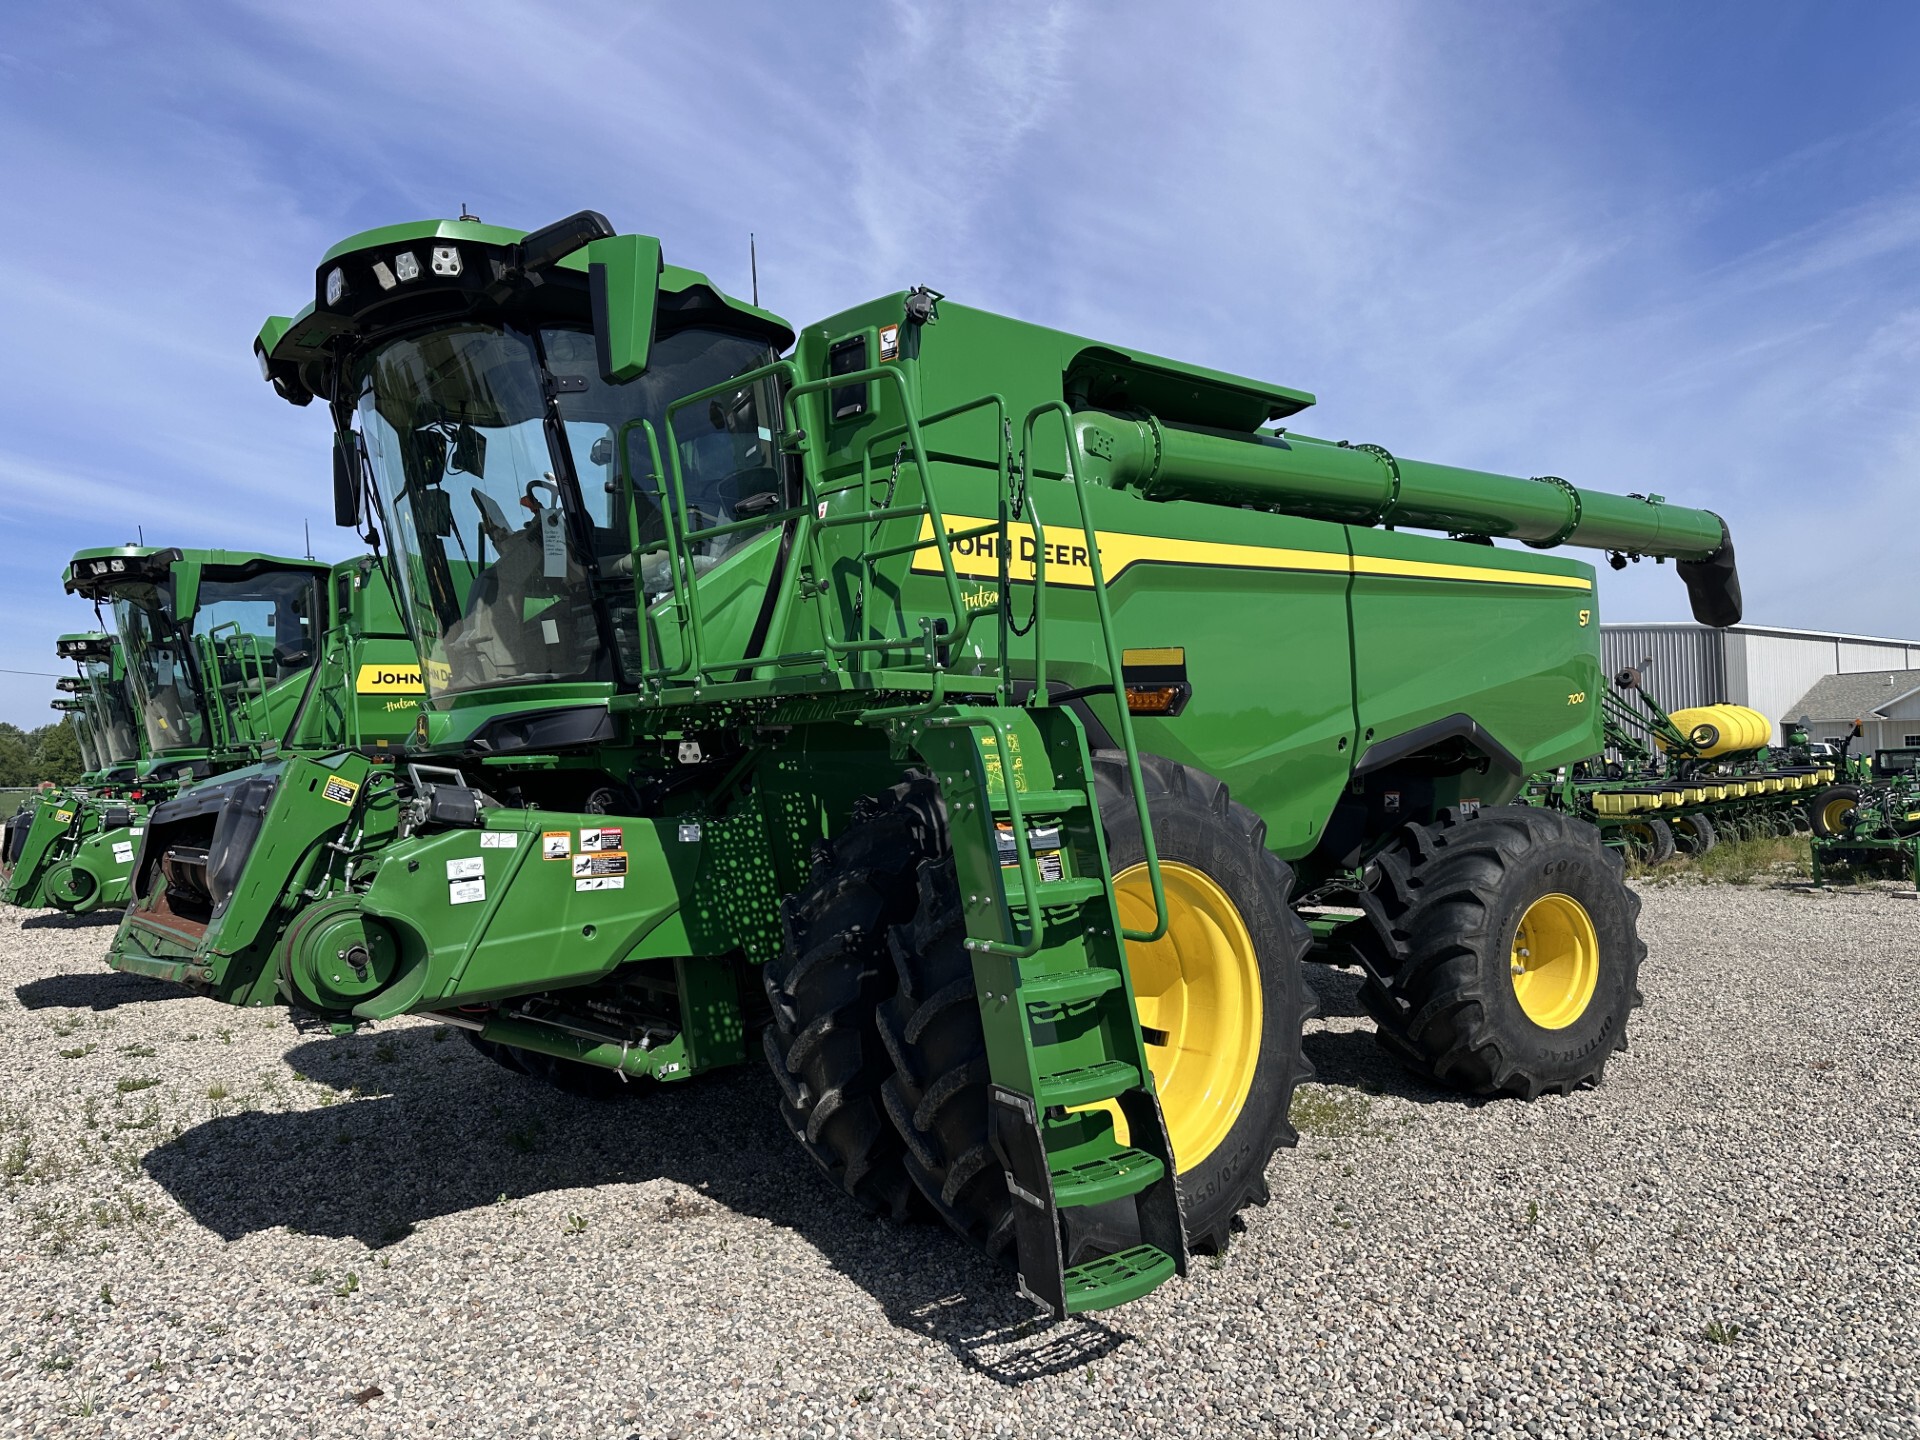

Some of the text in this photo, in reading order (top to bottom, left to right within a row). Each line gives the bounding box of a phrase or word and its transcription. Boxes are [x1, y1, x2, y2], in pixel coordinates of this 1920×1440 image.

[1020, 536, 1102, 567] DEER
[1579, 610, 1590, 627] S7
[372, 671, 422, 685] JOHN
[382, 698, 418, 712] Hutson
[1567, 692, 1585, 705] 700
[1538, 1015, 1612, 1063] OPTITRAC
[1184, 1140, 1251, 1208] 520/85R
